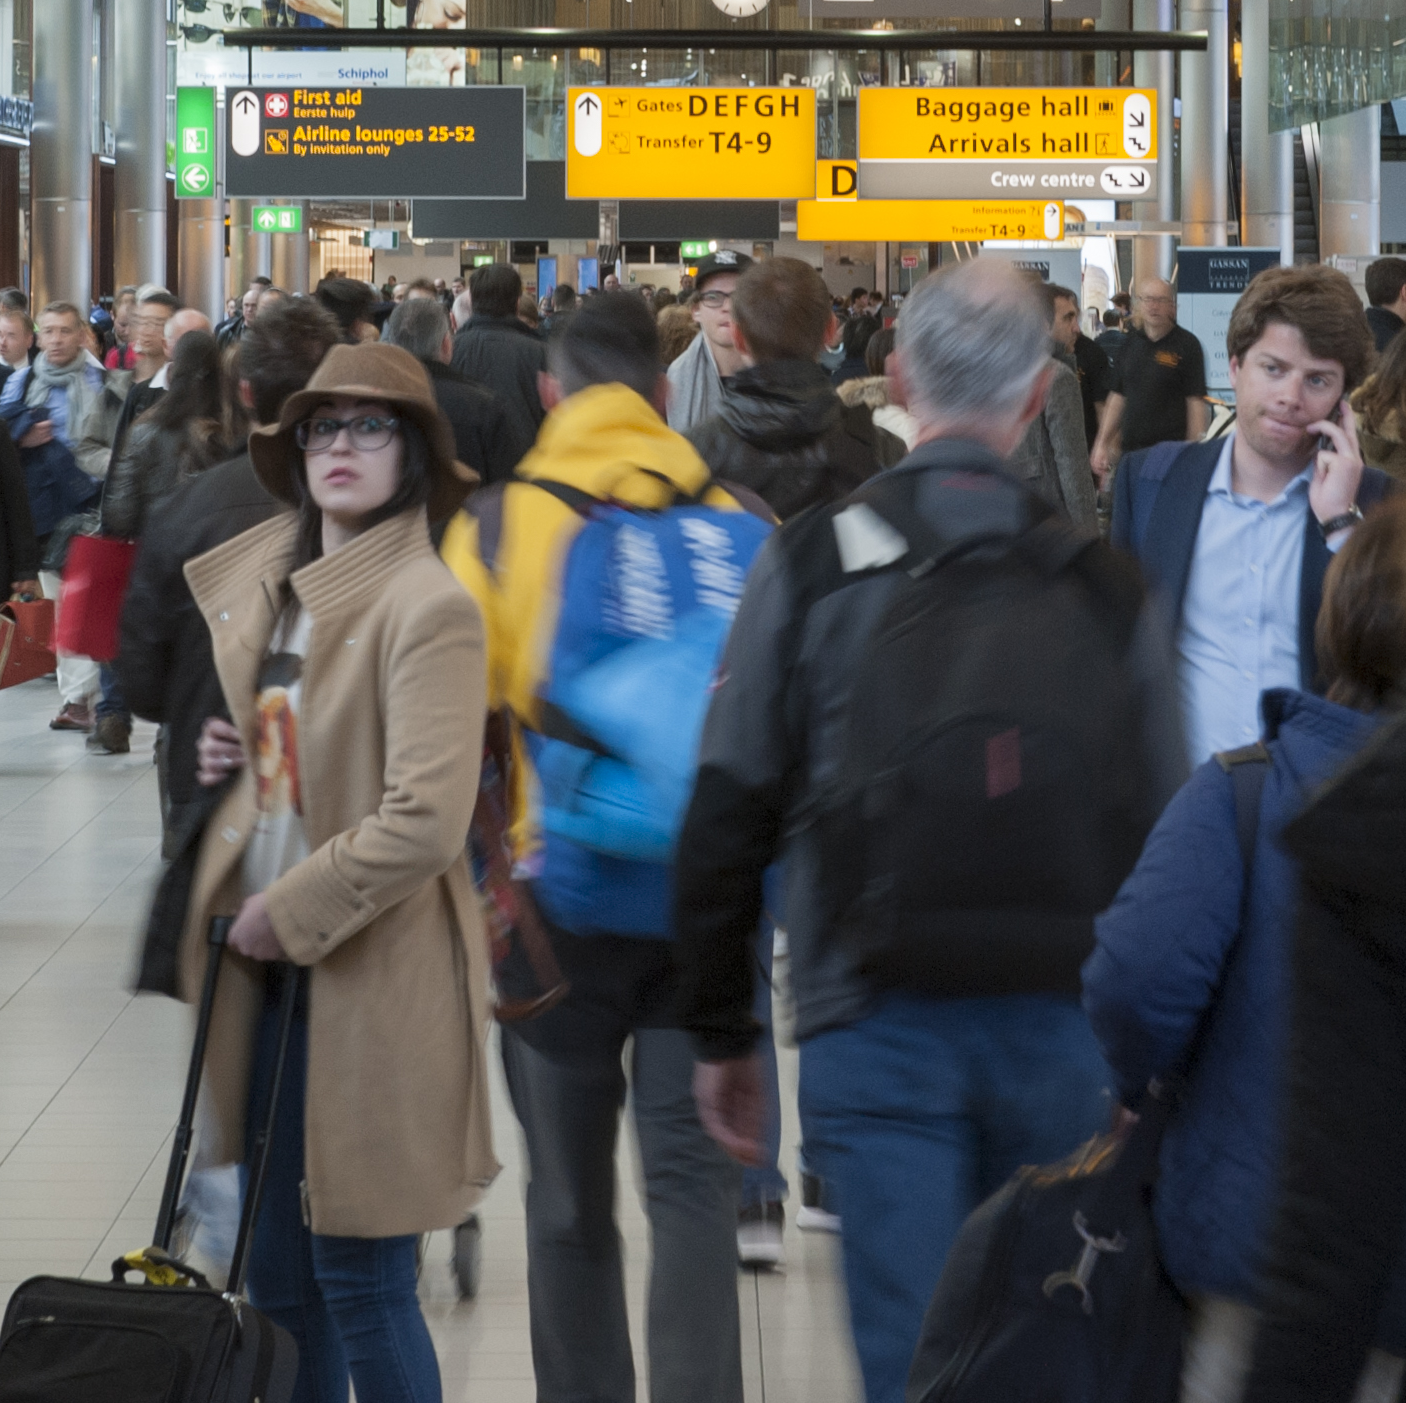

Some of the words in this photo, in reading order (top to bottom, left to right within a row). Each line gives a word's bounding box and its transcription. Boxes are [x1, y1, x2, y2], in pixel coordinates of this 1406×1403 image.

[229, 71, 248, 82] shop
[338, 67, 389, 81] Schiphol
[293, 89, 331, 106] First
[335, 89, 362, 106] aid
[637, 99, 683, 113] Gates
[916, 96, 1031, 122] Baggage
[1042, 95, 1089, 117] hall
[294, 107, 328, 119] Eerste
[330, 107, 356, 120] hulp
[293, 125, 351, 143] Airline
[355, 125, 424, 146] lounges
[428, 125, 476, 143] 25-52
[636, 135, 705, 149] Transfer
[709, 131, 772, 154] T4-9
[293, 143, 308, 157] By
[310, 143, 363, 156] invitation
[365, 143, 391, 157] only
[928, 132, 1031, 154] Arrivals
[1042, 132, 1089, 154] hall
[831, 165, 857, 197] D
[990, 170, 1036, 188] Crew
[1041, 171, 1096, 188] centre
[972, 205, 1026, 215] Information
[951, 224, 987, 236] Transfer
[990, 224, 1026, 237] T4-9
[1210, 259, 1248, 268] GASSAN
